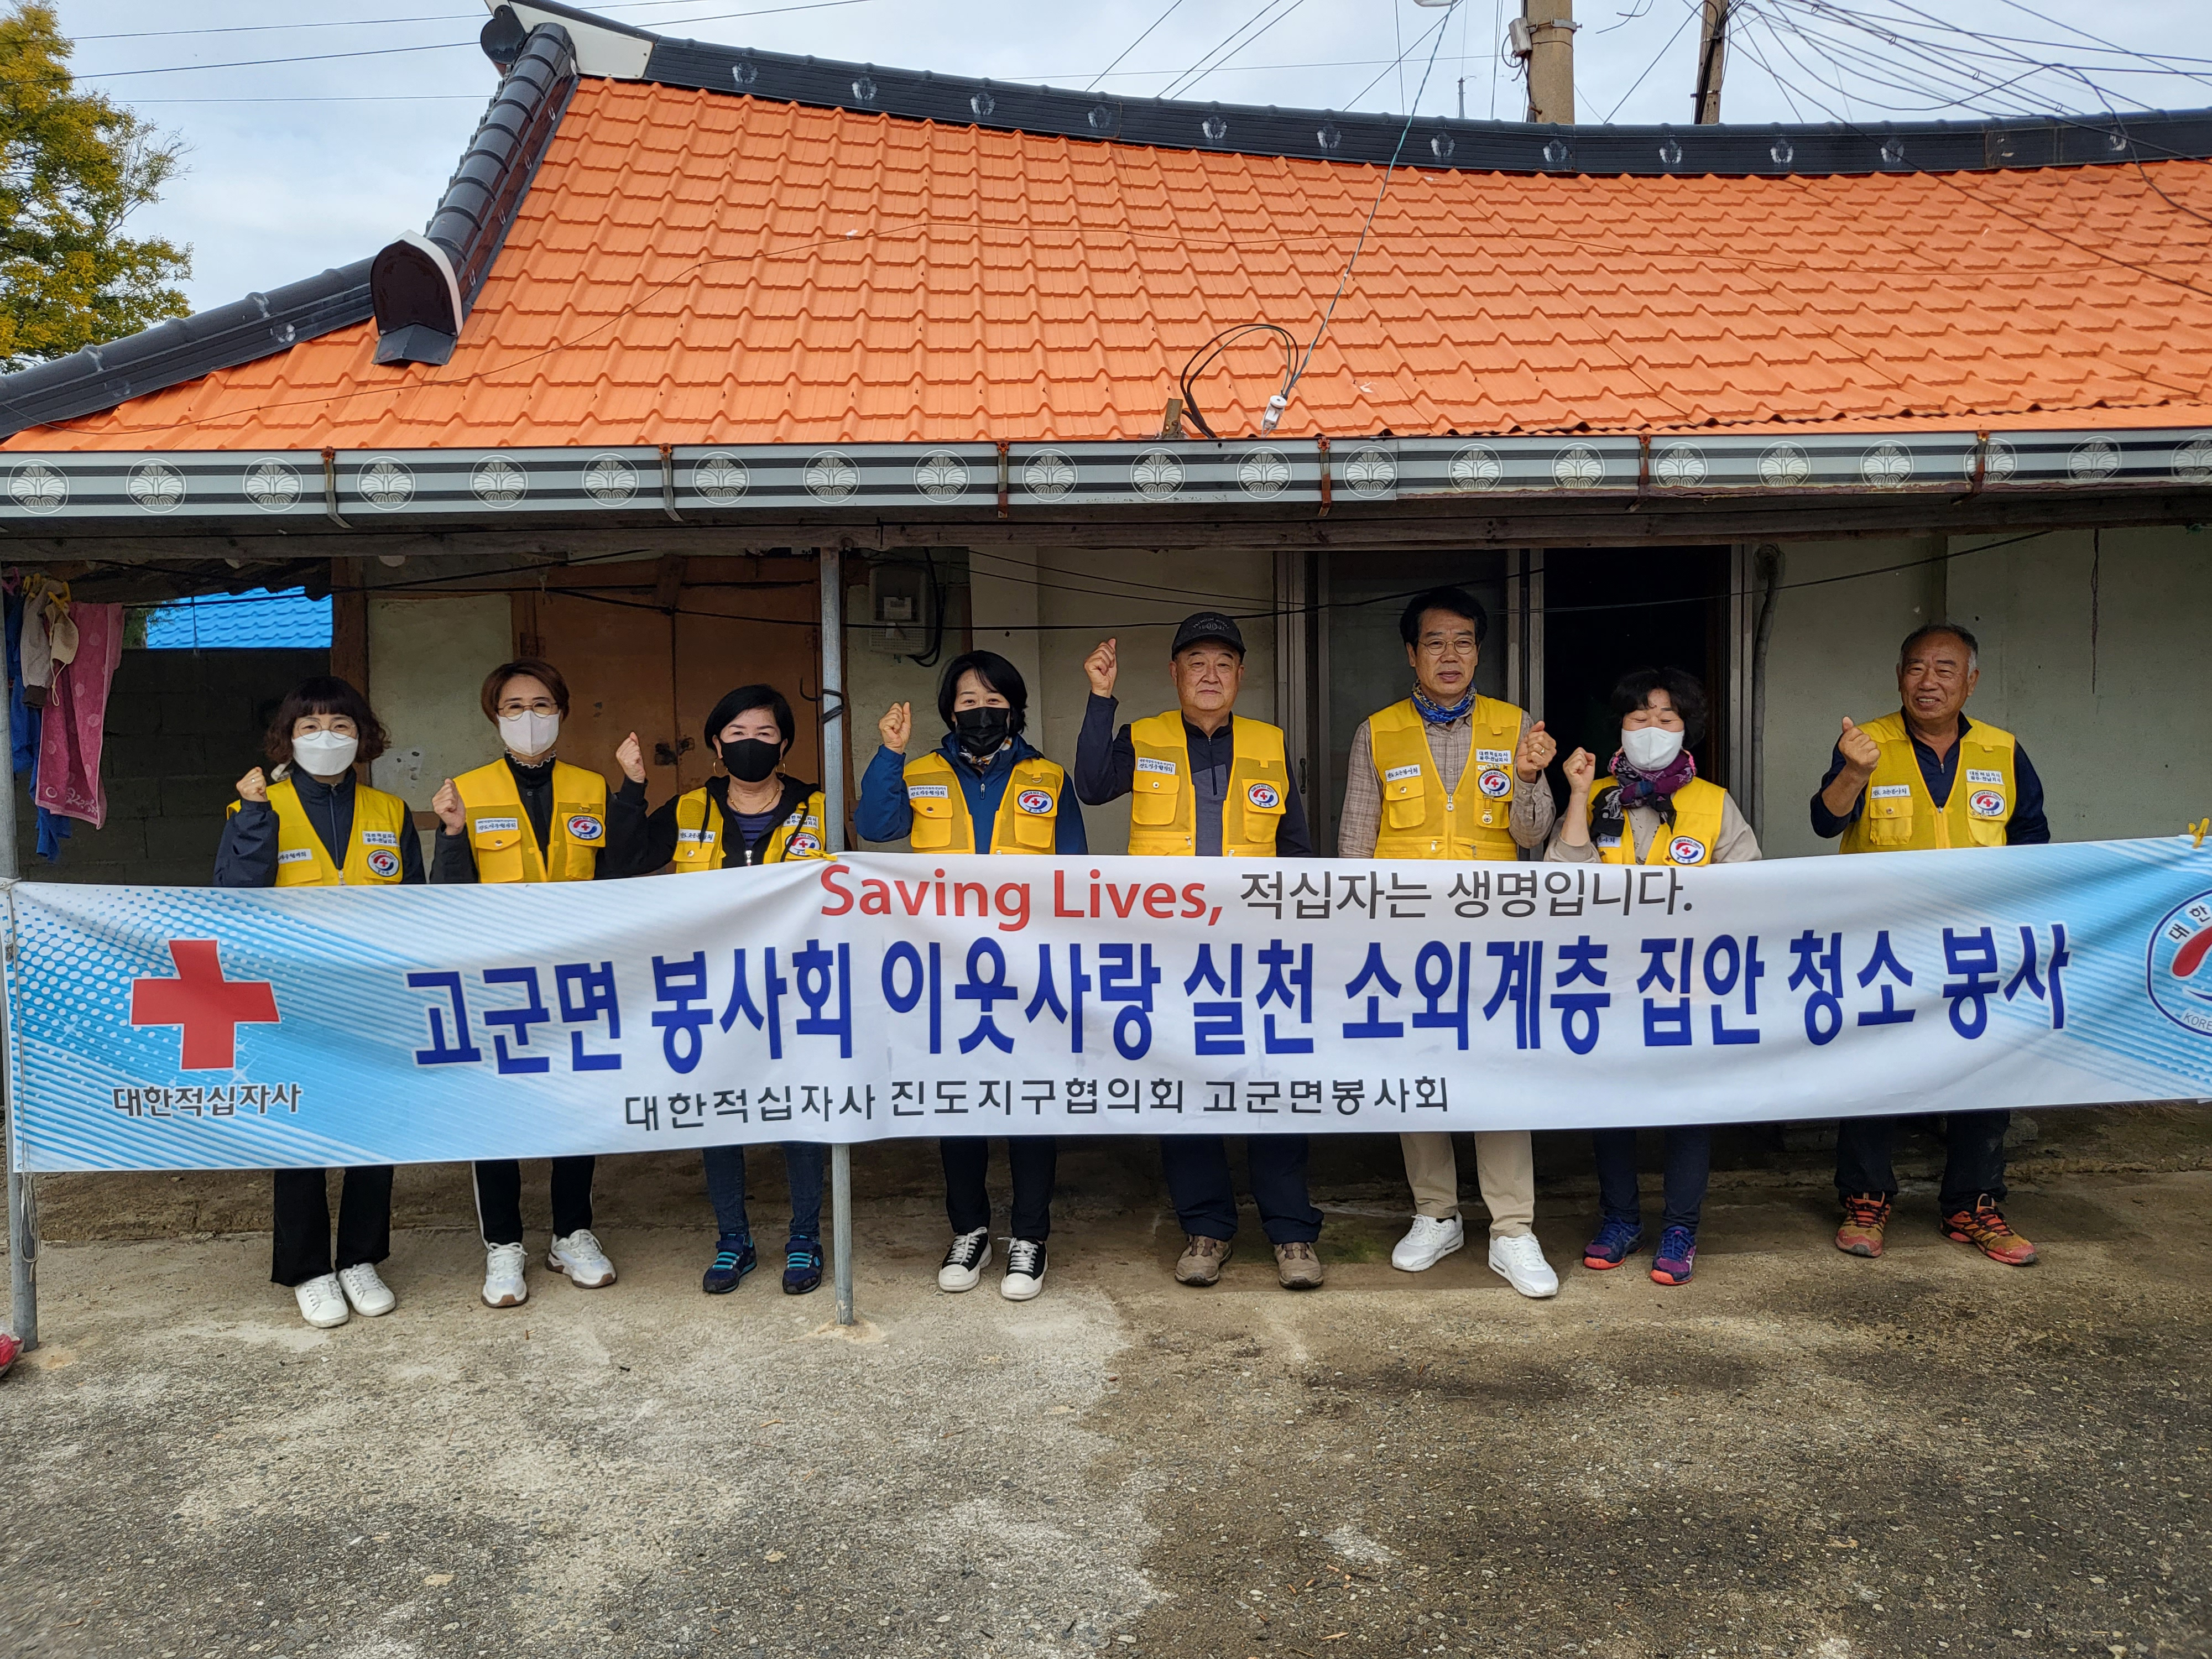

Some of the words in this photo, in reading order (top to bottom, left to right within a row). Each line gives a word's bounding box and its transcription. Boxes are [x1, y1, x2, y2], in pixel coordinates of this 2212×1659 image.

[821, 864, 1030, 932] Saving
[1054, 869, 1223, 926] Lives,
[1240, 870, 1432, 920] 적십자는
[1447, 867, 1693, 919] 생명입니다.
[406, 961, 622, 1075] 고군면
[651, 938, 852, 1074] 봉사회
[881, 937, 1161, 1061] 이웃사랑
[1183, 938, 1314, 1056] 실천
[1342, 935, 1611, 1056] 소외계층
[1636, 935, 1765, 1046] 집안
[1788, 930, 1916, 1046] 청소
[1943, 924, 2070, 1040] 봉사
[113, 1083, 302, 1117] 대한적십자사
[625, 1084, 876, 1131] 대한적십자사
[891, 1077, 1183, 1117] 진도지구협의회
[1203, 1076, 1448, 1116] 고군면봉사회
